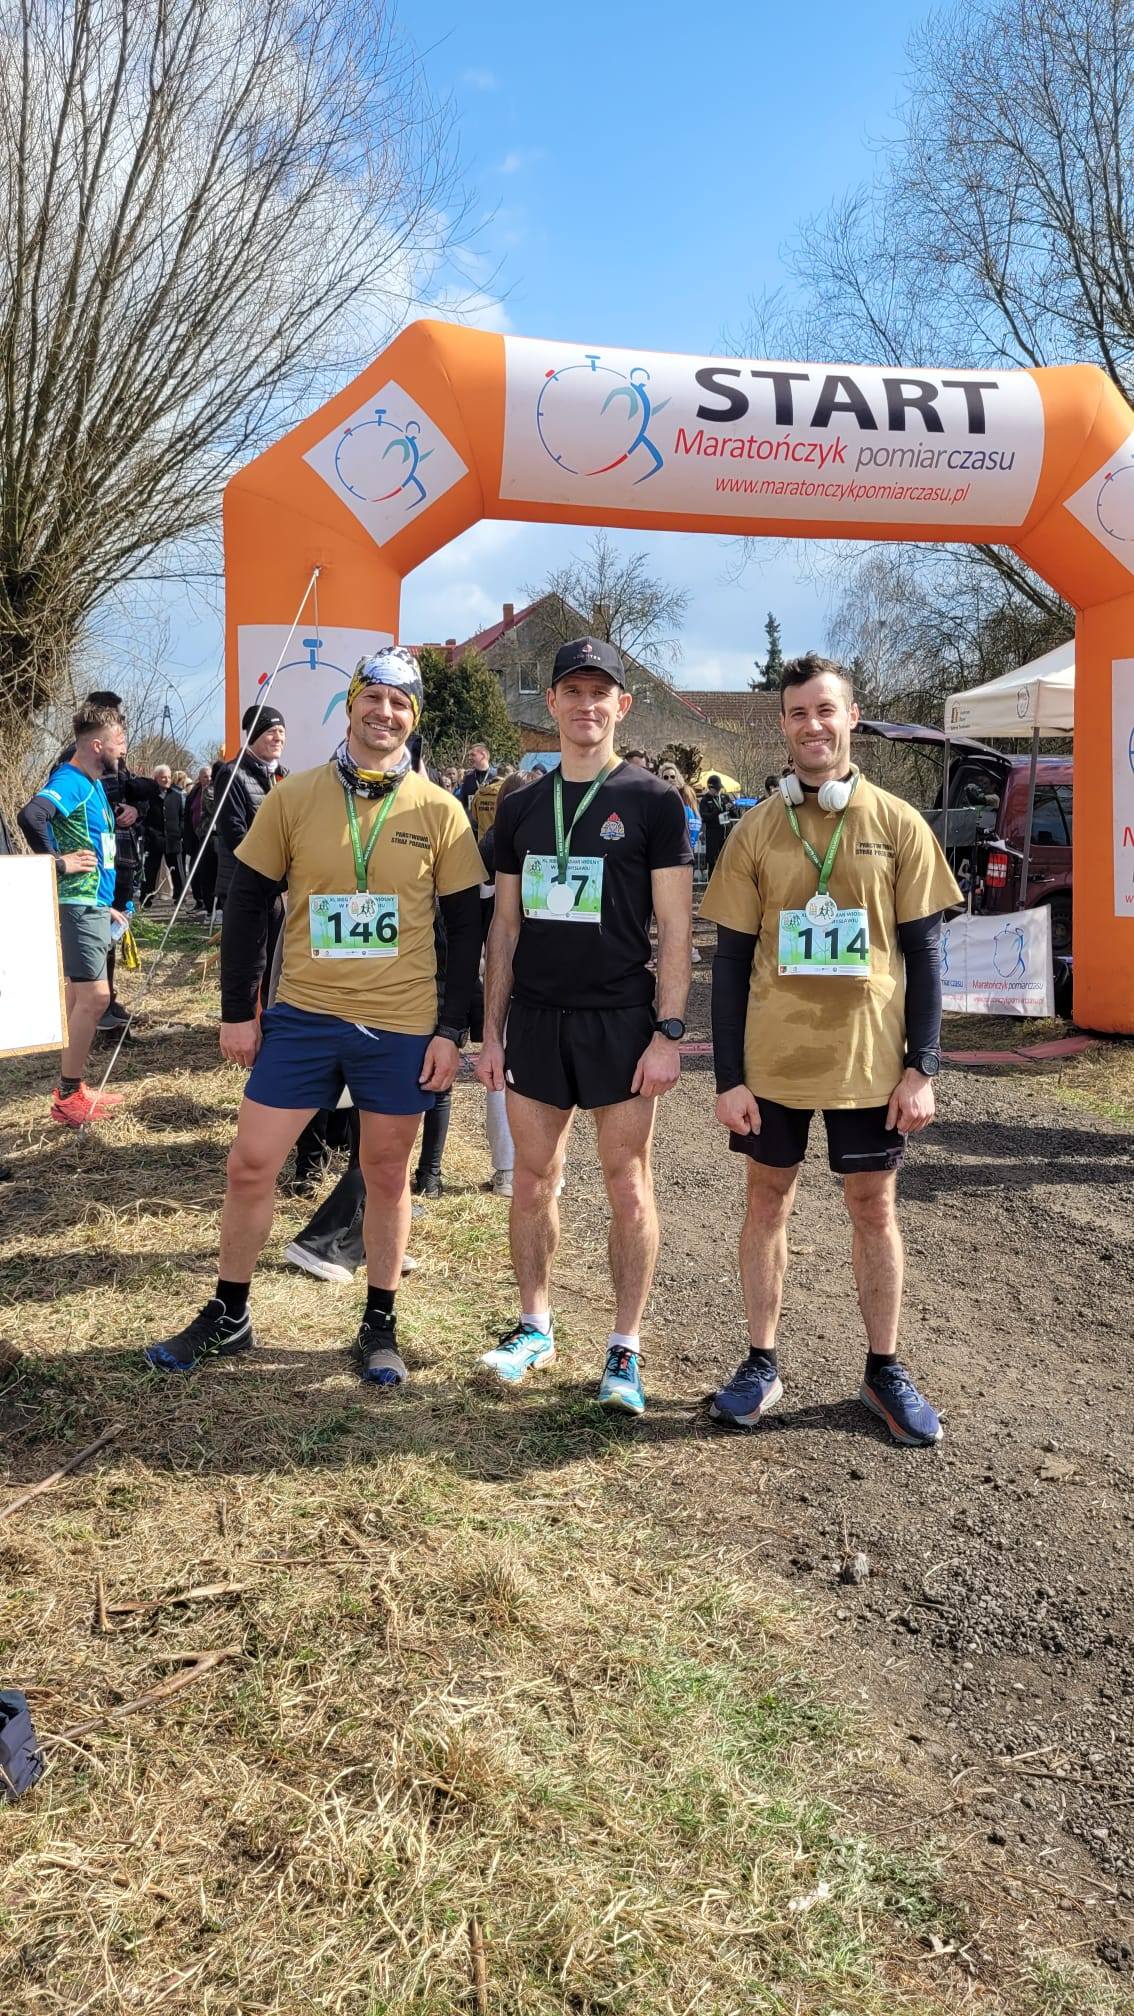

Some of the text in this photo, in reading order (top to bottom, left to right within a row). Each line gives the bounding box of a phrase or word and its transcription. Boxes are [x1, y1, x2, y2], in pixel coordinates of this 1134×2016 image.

[695, 367, 999, 434] START
[674, 428, 848, 470] Maratończyk
[715, 477, 971, 505] www.maratonczykpomiarczasu.pl
[327, 911, 398, 944] 146
[798, 927, 869, 961] 114
